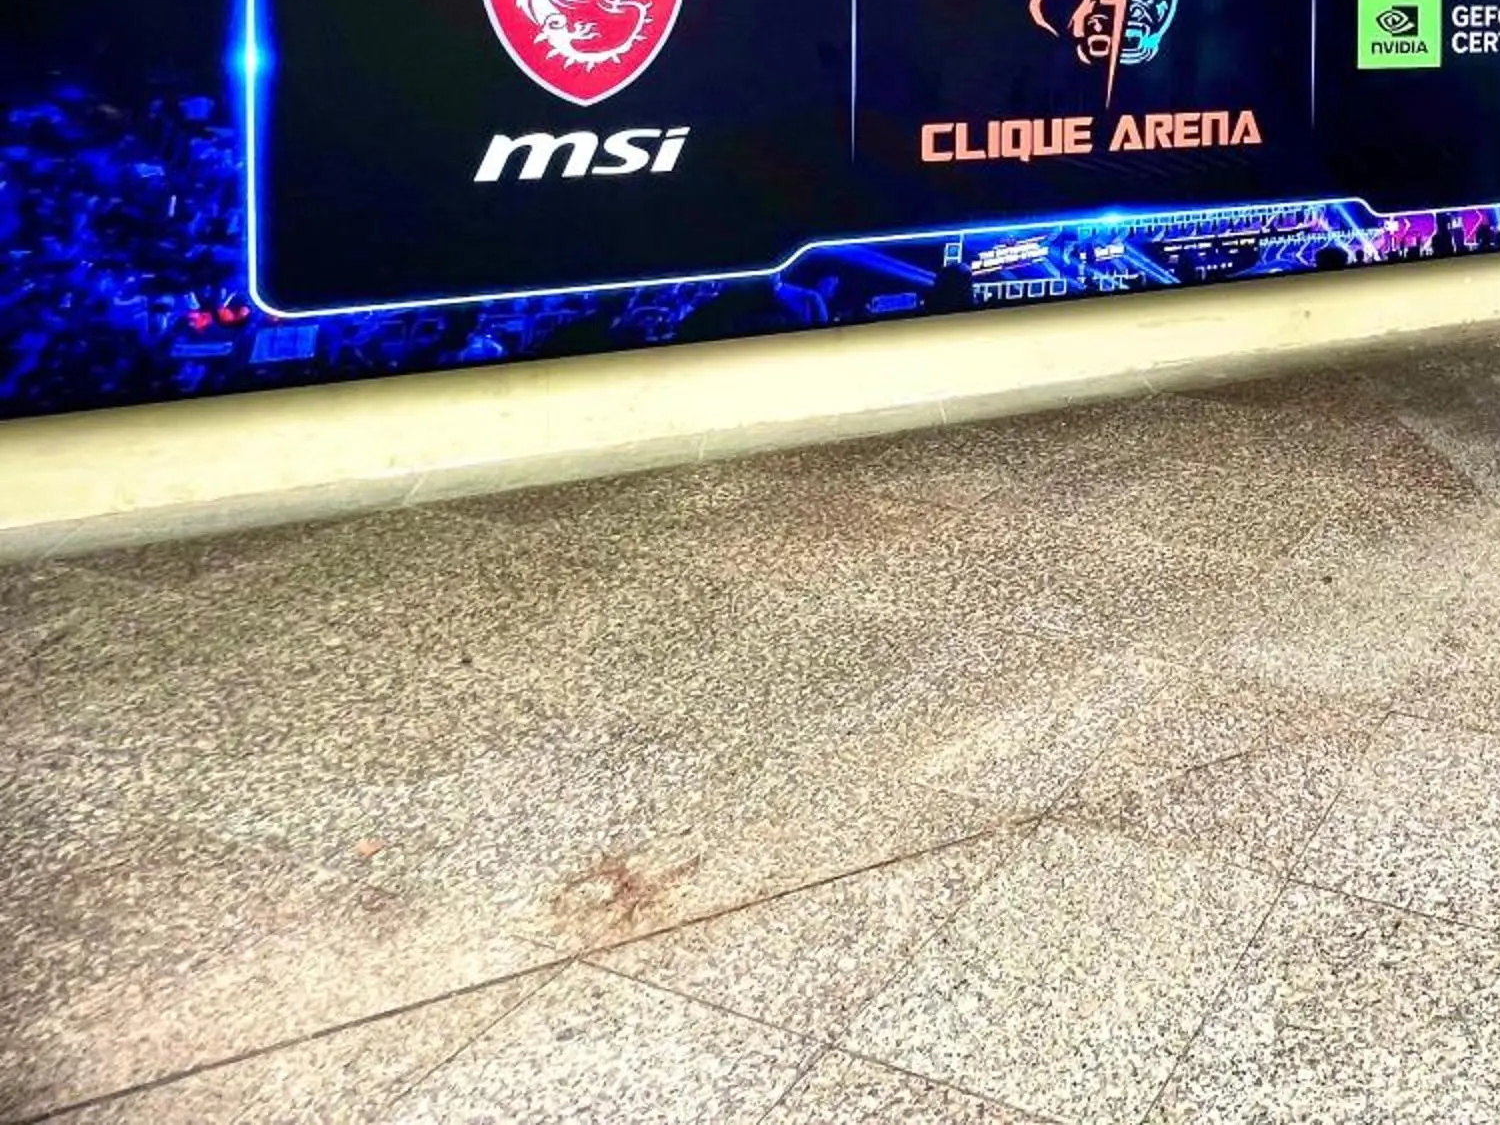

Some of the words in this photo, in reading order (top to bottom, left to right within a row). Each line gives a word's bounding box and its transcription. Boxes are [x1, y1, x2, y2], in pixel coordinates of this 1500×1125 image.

[473, 127, 691, 182] msi
[921, 117, 1094, 162] CLIQUE
[1108, 110, 1263, 152] ARENA
